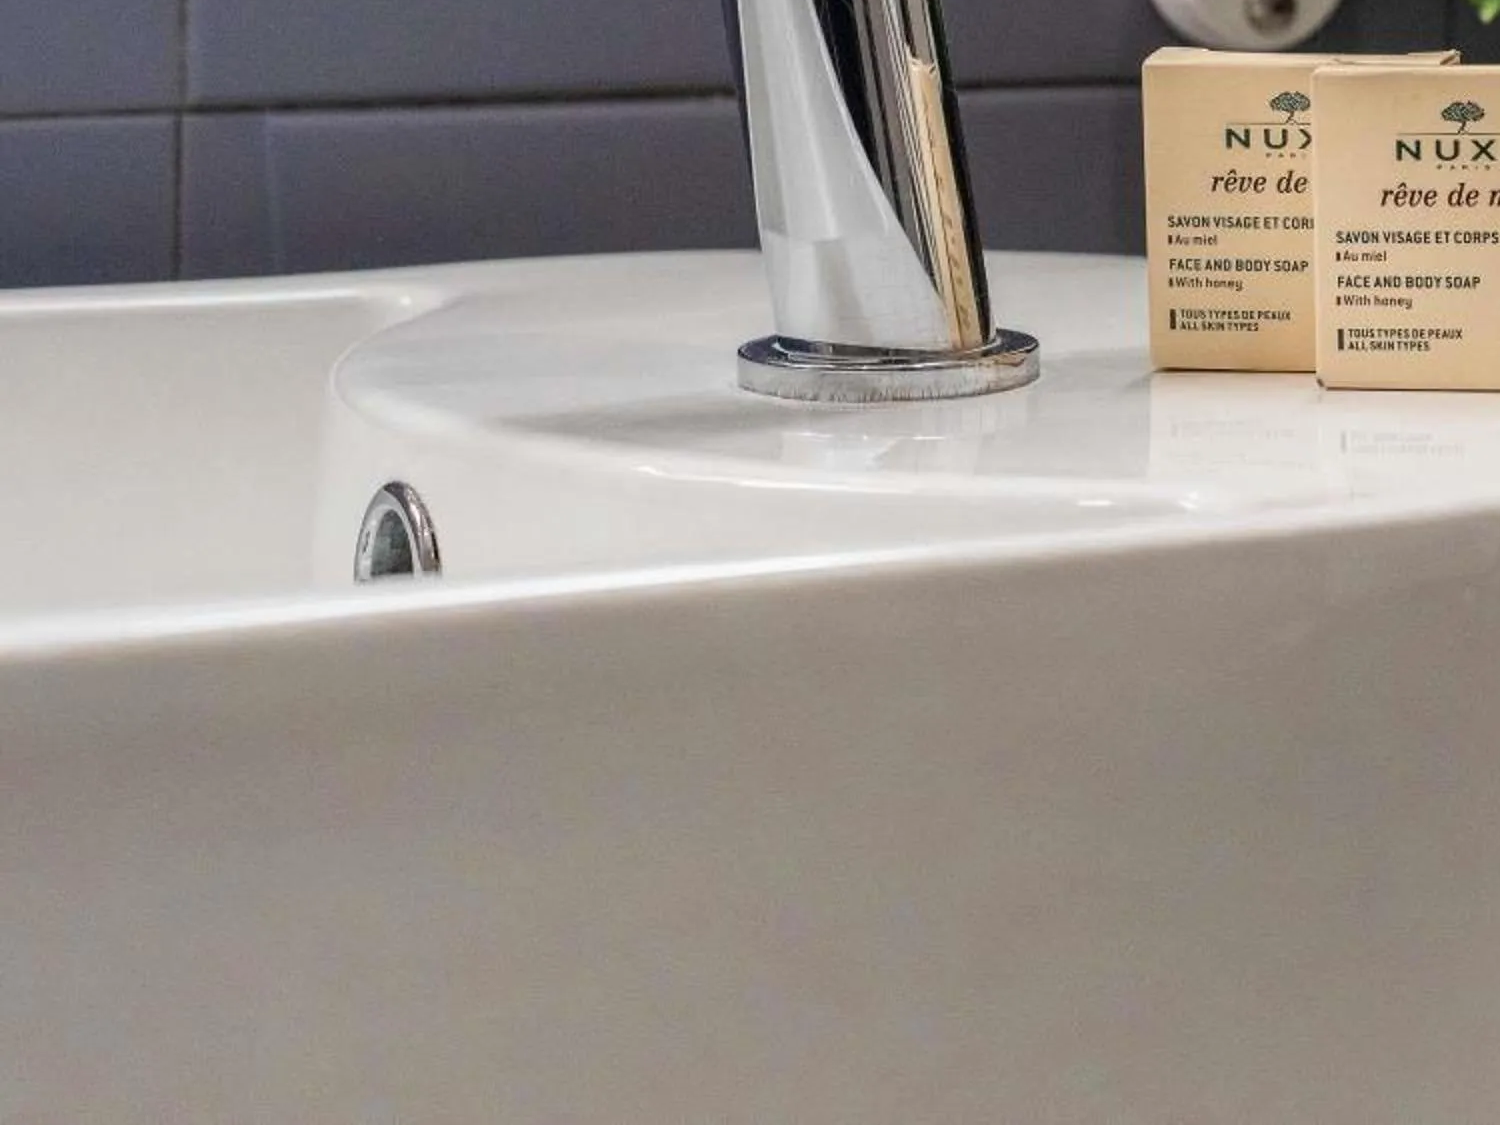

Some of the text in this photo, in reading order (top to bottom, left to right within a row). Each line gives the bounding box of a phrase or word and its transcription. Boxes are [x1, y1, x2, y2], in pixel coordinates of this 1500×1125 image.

[1225, 128, 1312, 150] NUX
[1211, 169, 1308, 194] rêve de
[1380, 182, 1438, 208] rêve
[1447, 183, 1480, 208] de
[1167, 215, 1210, 229] SAVON
[1213, 216, 1261, 229] VISAGE
[1263, 216, 1279, 230] ET
[1175, 235, 1218, 246] Au miel
[1335, 230, 1500, 245] SAVON VISAGE ET CORPS
[1343, 251, 1387, 263] Au miel
[1169, 258, 1309, 272] FACE AND BODY SOAP
[1176, 277, 1243, 292] With honey
[1337, 276, 1481, 290] FACE AND BODY SOAP
[1343, 295, 1413, 310] With honey
[1180, 309, 1207, 320] TOUS
[1180, 321, 1260, 332] ALL SKIN TYPES
[1348, 329, 1463, 340] TOUS TYPES DE PEAUX
[1348, 341, 1431, 352] ALL SKIN TYPES
